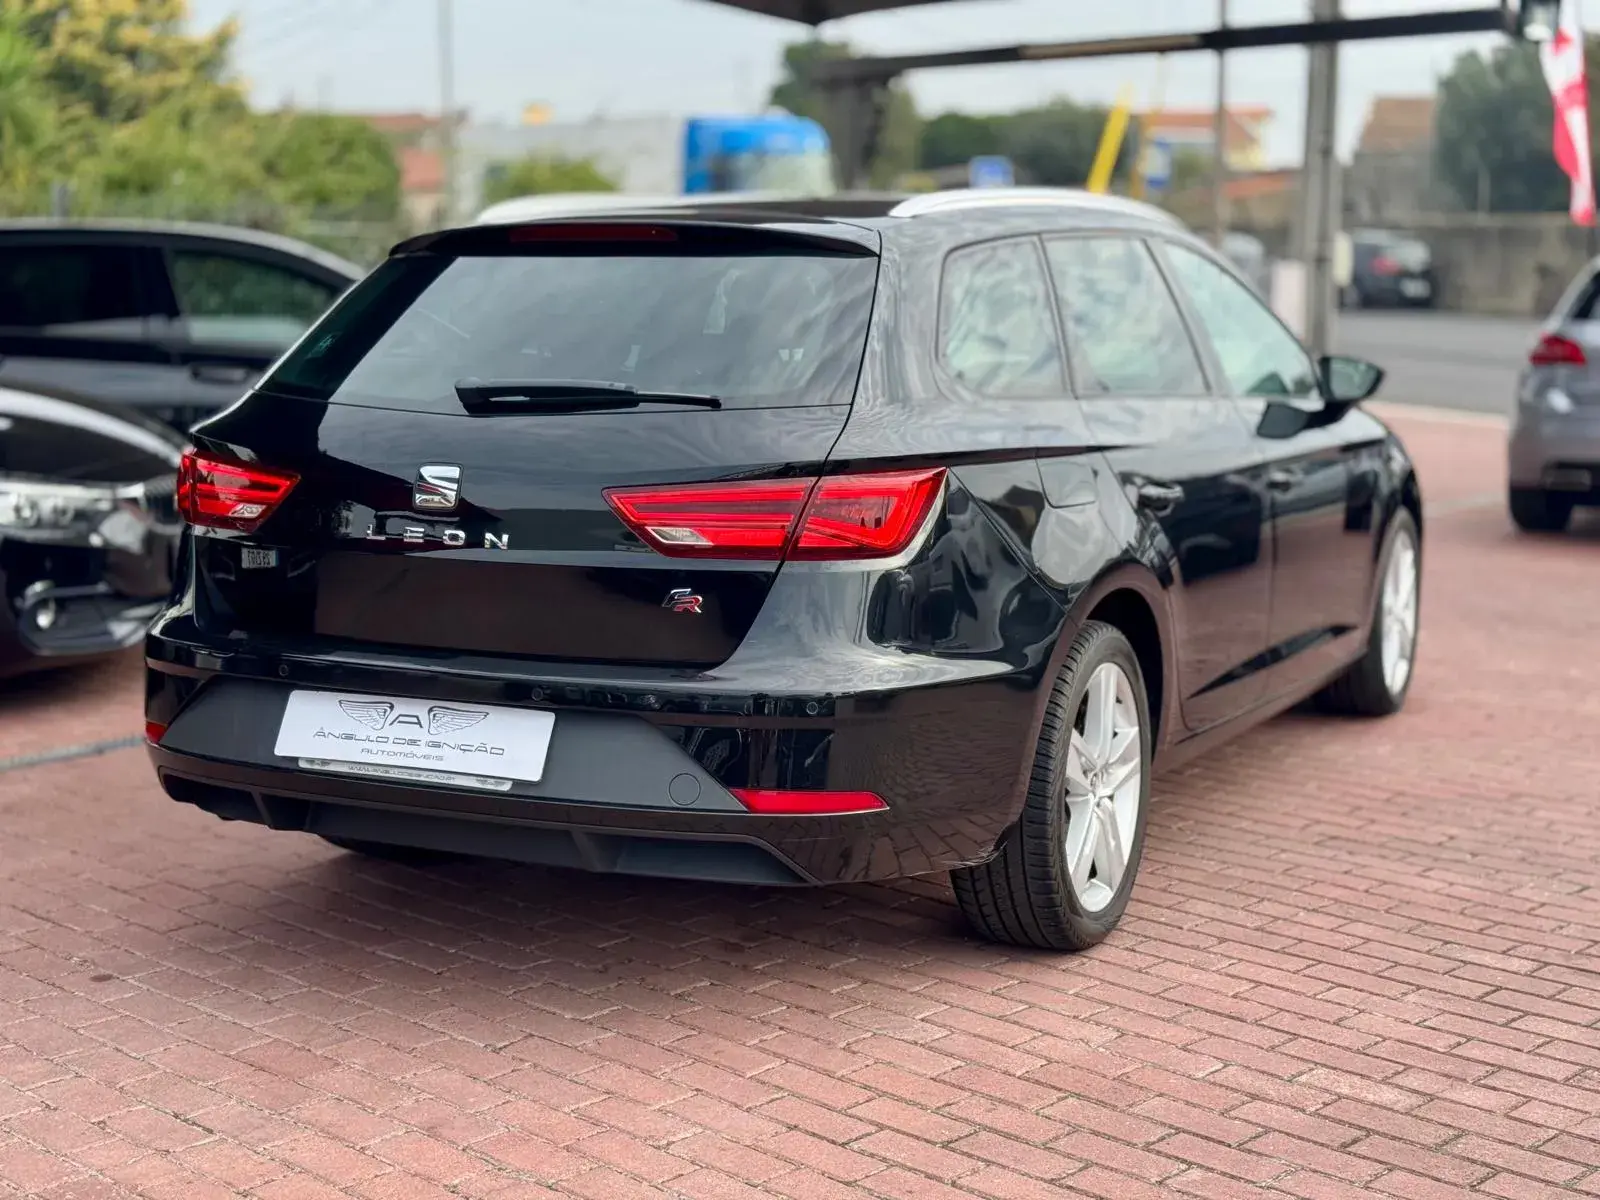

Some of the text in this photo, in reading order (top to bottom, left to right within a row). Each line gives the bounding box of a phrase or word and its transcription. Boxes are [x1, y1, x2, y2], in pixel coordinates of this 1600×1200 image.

[366, 523, 509, 550] LEON
[661, 588, 703, 613] FR
[360, 748, 444, 762] AUTOMÓVEIS
[392, 737, 421, 747] DE
[425, 740, 505, 756] IGNIÇÃO
